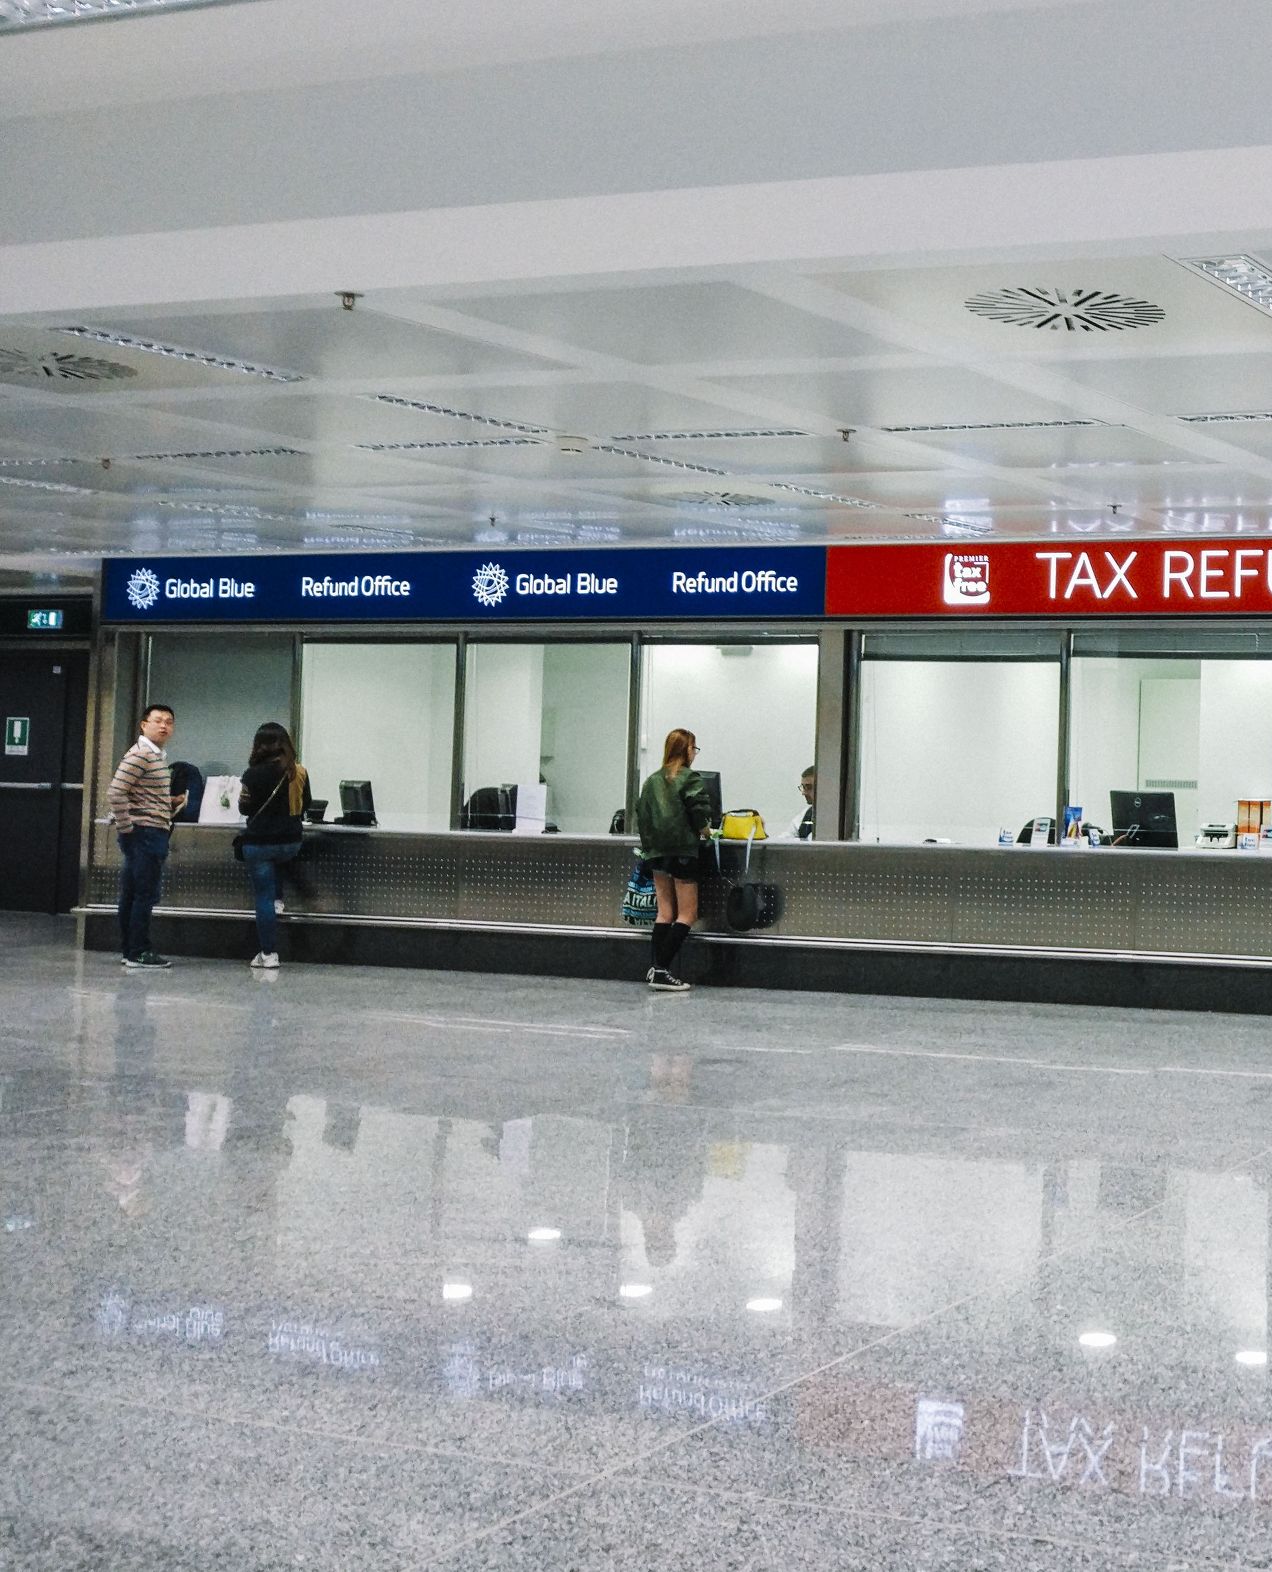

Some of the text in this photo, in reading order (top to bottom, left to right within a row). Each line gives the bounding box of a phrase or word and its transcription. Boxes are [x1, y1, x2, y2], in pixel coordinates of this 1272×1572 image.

[953, 554, 989, 563] PREMIER
[953, 561, 982, 578] tax
[1035, 551, 1139, 599] TAX
[165, 577, 256, 598] Global Blue
[301, 575, 411, 597] Refund Office
[515, 573, 618, 595] Global Blue
[672, 570, 799, 593] Refund Office
[953, 577, 988, 593] free
[631, 893, 658, 908] ITALI
